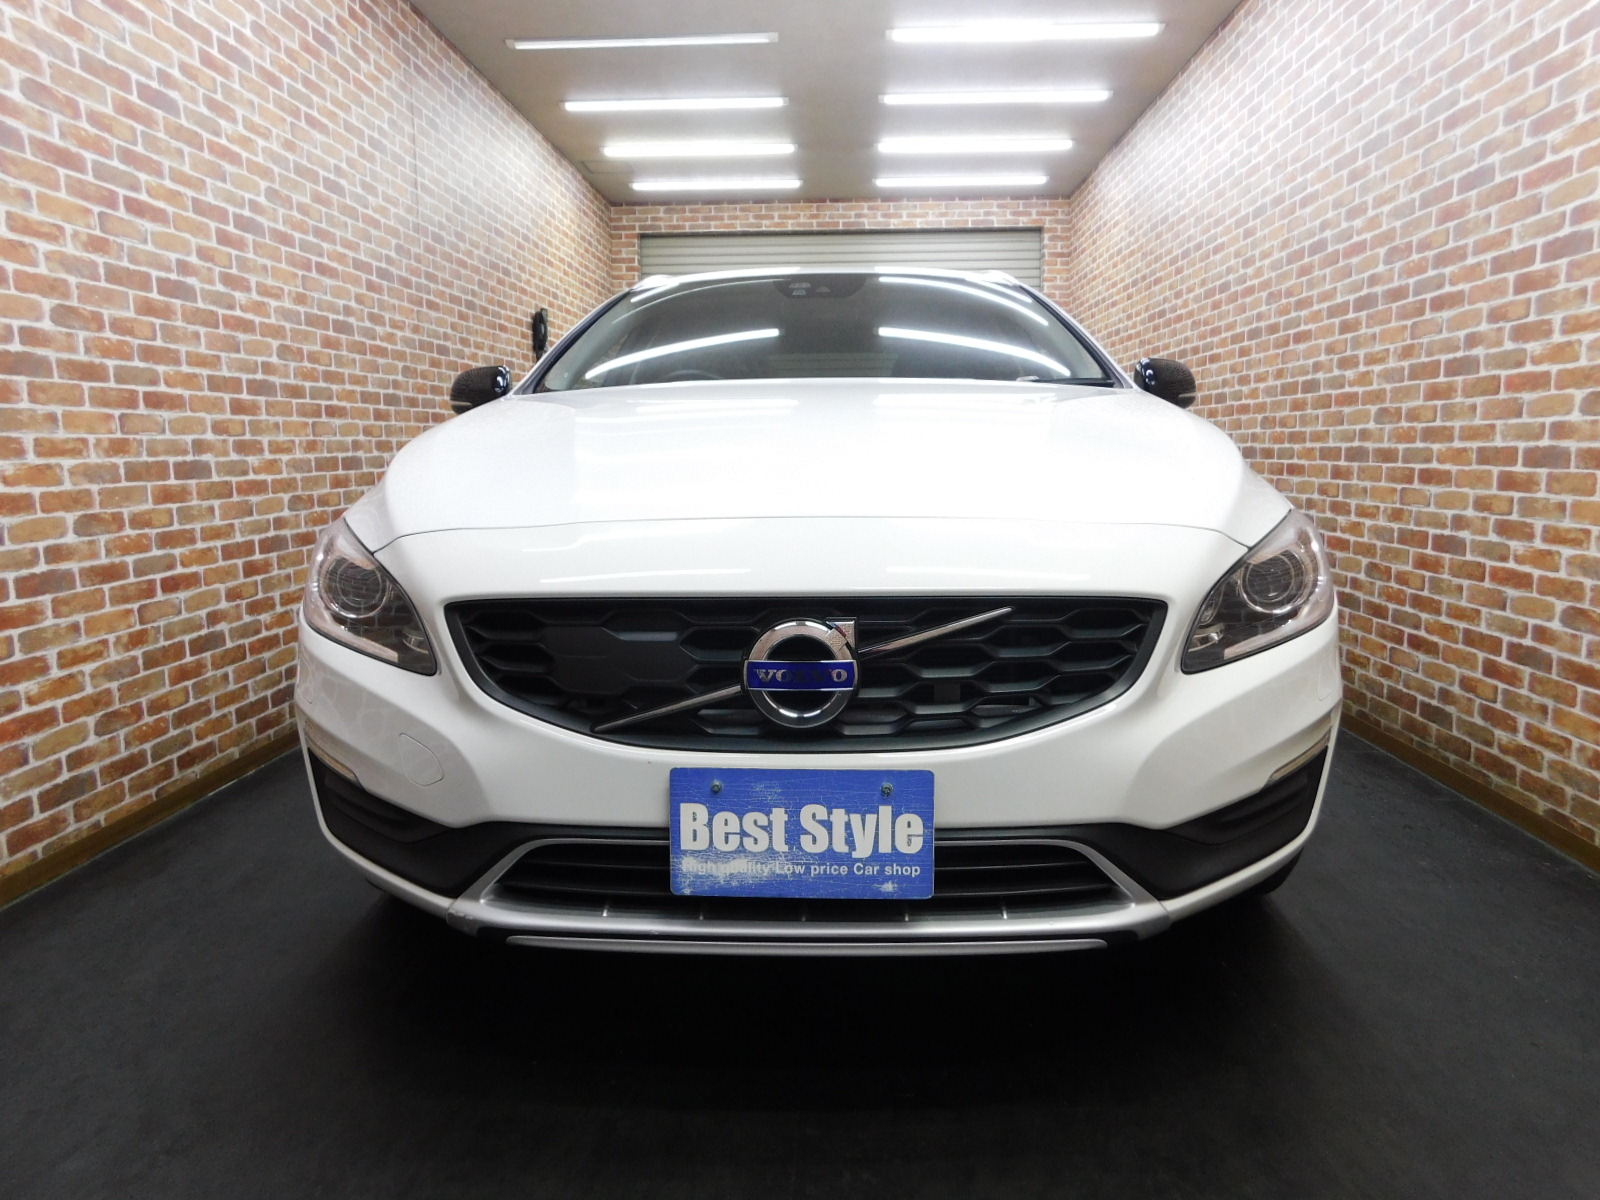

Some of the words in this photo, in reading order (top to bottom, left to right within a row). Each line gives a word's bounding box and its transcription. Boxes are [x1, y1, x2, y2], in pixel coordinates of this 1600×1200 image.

[754, 668, 848, 683] VOLVO
[679, 802, 789, 853] Best
[799, 803, 924, 858] Style
[682, 860, 717, 875] igh
[775, 861, 805, 875] Low
[810, 863, 849, 878] price
[853, 862, 880, 875] Car
[884, 862, 921, 877] shop
